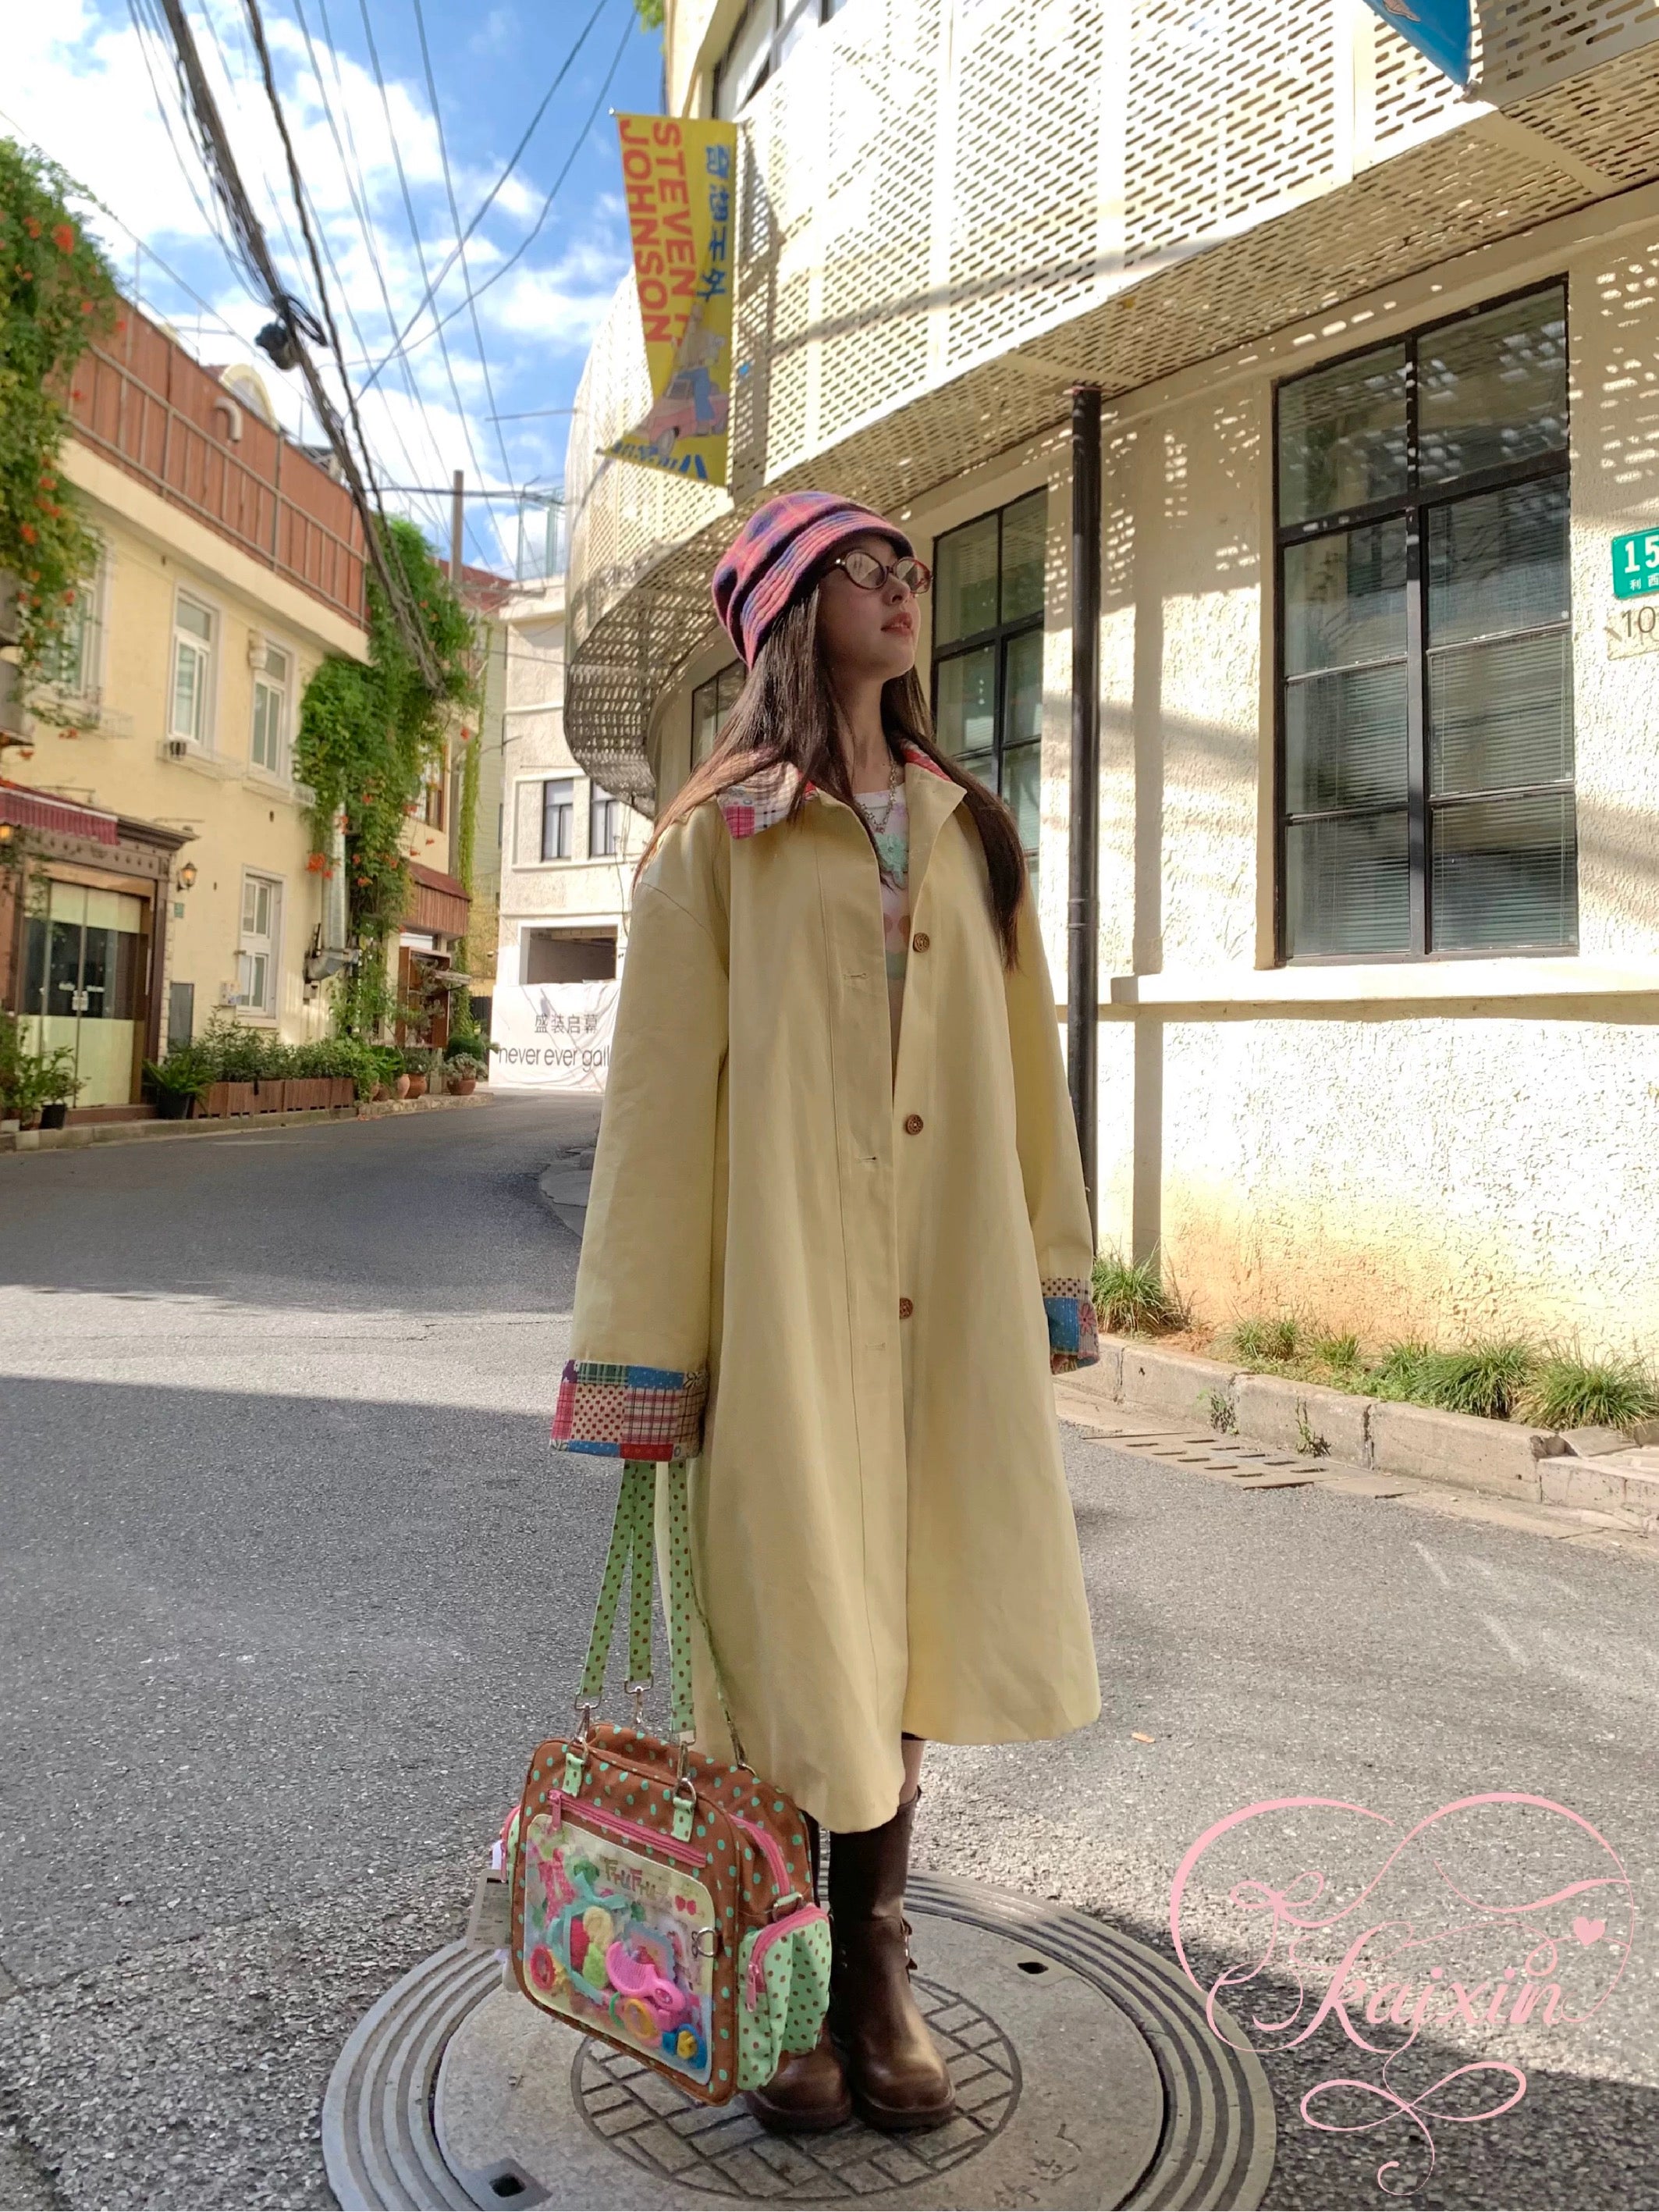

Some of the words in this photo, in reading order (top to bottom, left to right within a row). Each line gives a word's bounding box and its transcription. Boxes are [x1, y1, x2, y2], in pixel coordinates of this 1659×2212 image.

[619, 119, 672, 343] JOHNSON
[653, 121, 697, 299] STEVEN
[499, 1047, 541, 1065] never
[544, 1049, 577, 1066] ever
[535, 1013, 599, 1034] 盛装启幕
